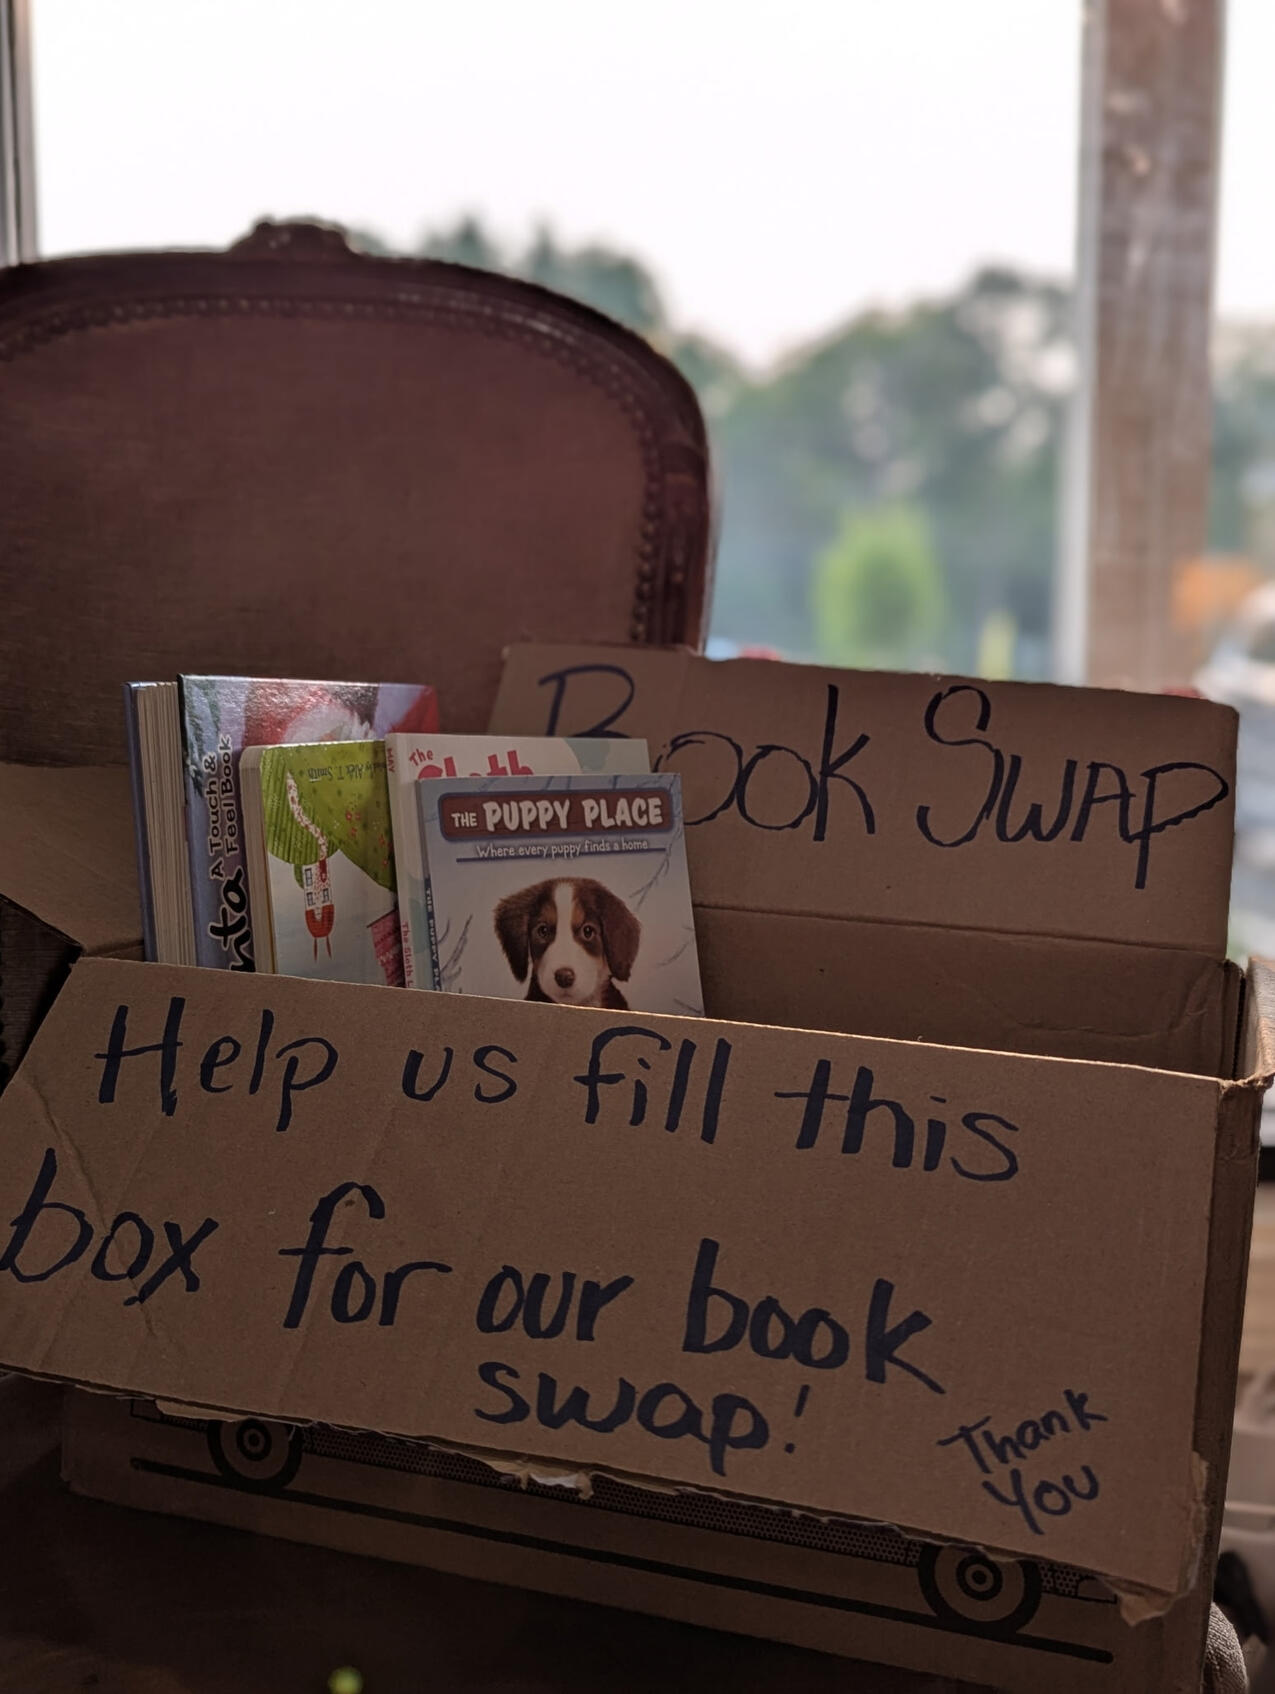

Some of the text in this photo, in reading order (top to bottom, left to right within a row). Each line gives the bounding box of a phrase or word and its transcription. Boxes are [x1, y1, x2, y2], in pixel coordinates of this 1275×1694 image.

[219, 734, 239, 857] Feel Book
[409, 748, 434, 767] The
[451, 797, 664, 832] THE PUPPY PLACE
[203, 752, 225, 880] A Touch &
[476, 838, 649, 859] Where every puppy finds a home
[94, 996, 1020, 1182] Help us fill this
[0, 1147, 946, 1395] box for our book
[474, 1361, 811, 1476] swap!
[937, 1388, 1109, 1475] Thank
